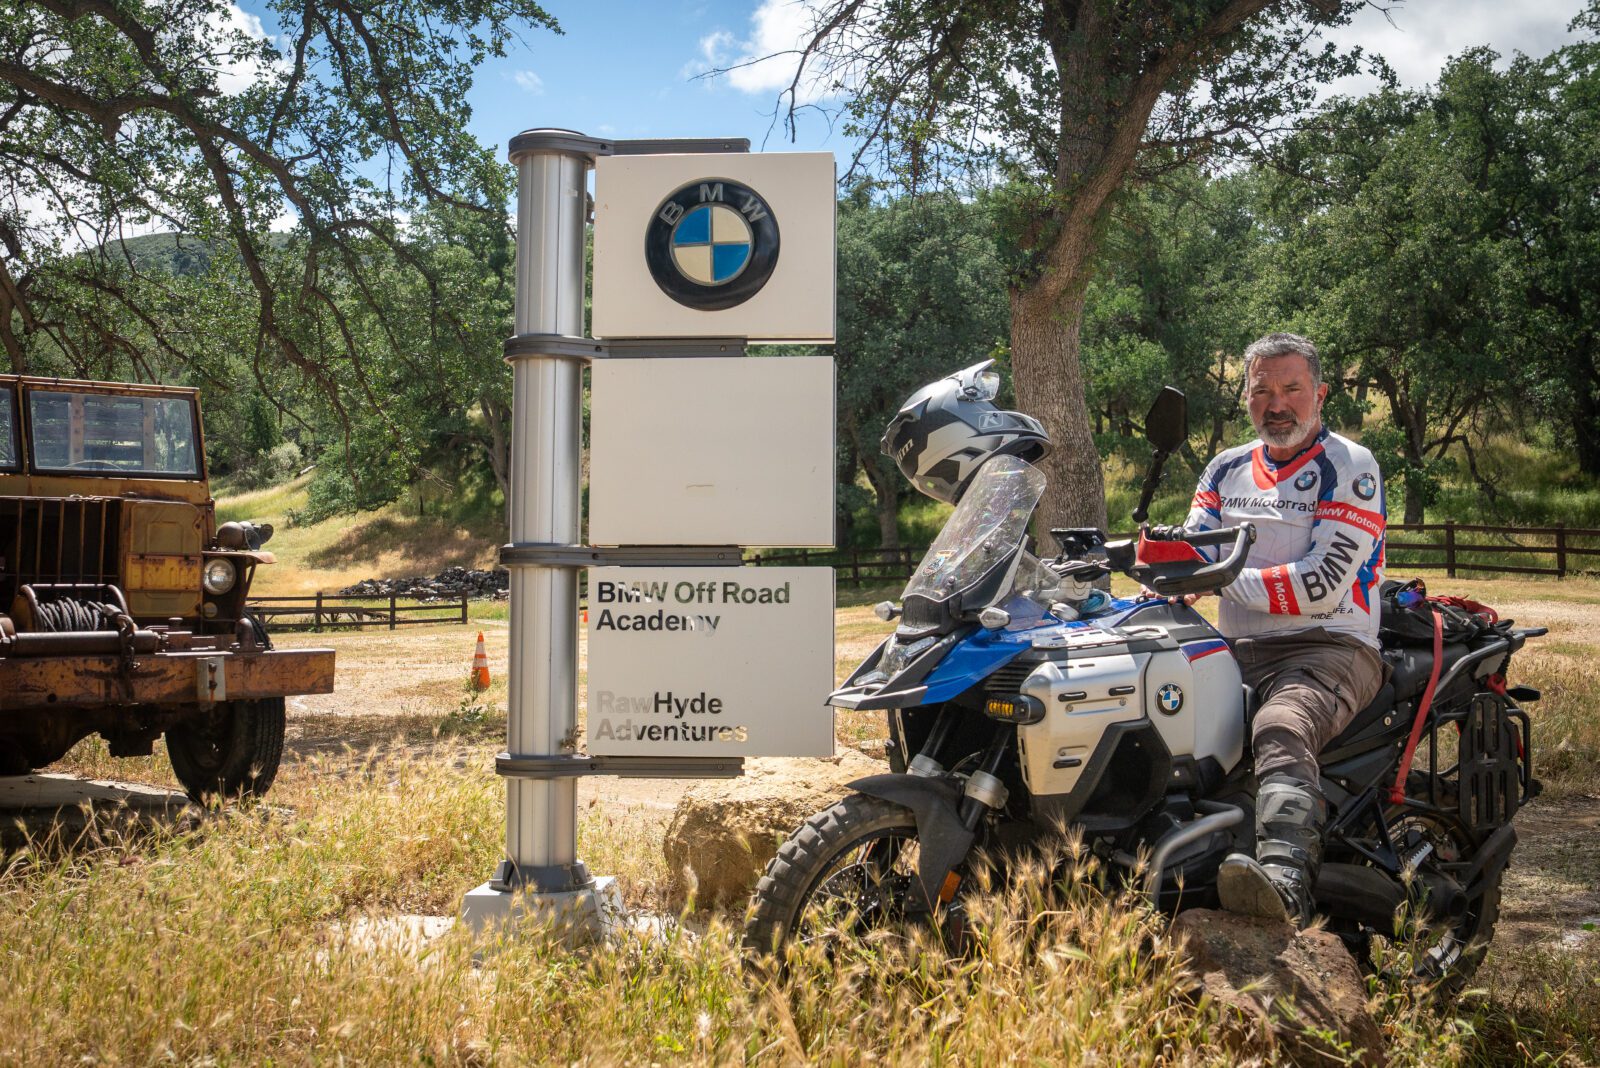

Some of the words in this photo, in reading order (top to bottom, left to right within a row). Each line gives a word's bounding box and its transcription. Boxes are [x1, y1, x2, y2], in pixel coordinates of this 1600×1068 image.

[658, 182, 768, 226] BMW
[1219, 496, 1250, 508] BMW
[1250, 497, 1317, 512] Motorrad
[1315, 507, 1345, 517] BMW
[1300, 530, 1360, 603] BMW
[597, 581, 669, 603] BMW
[674, 581, 717, 604] Off
[722, 581, 791, 604] Road
[596, 609, 721, 637] Academy
[595, 718, 748, 742] Adventures
